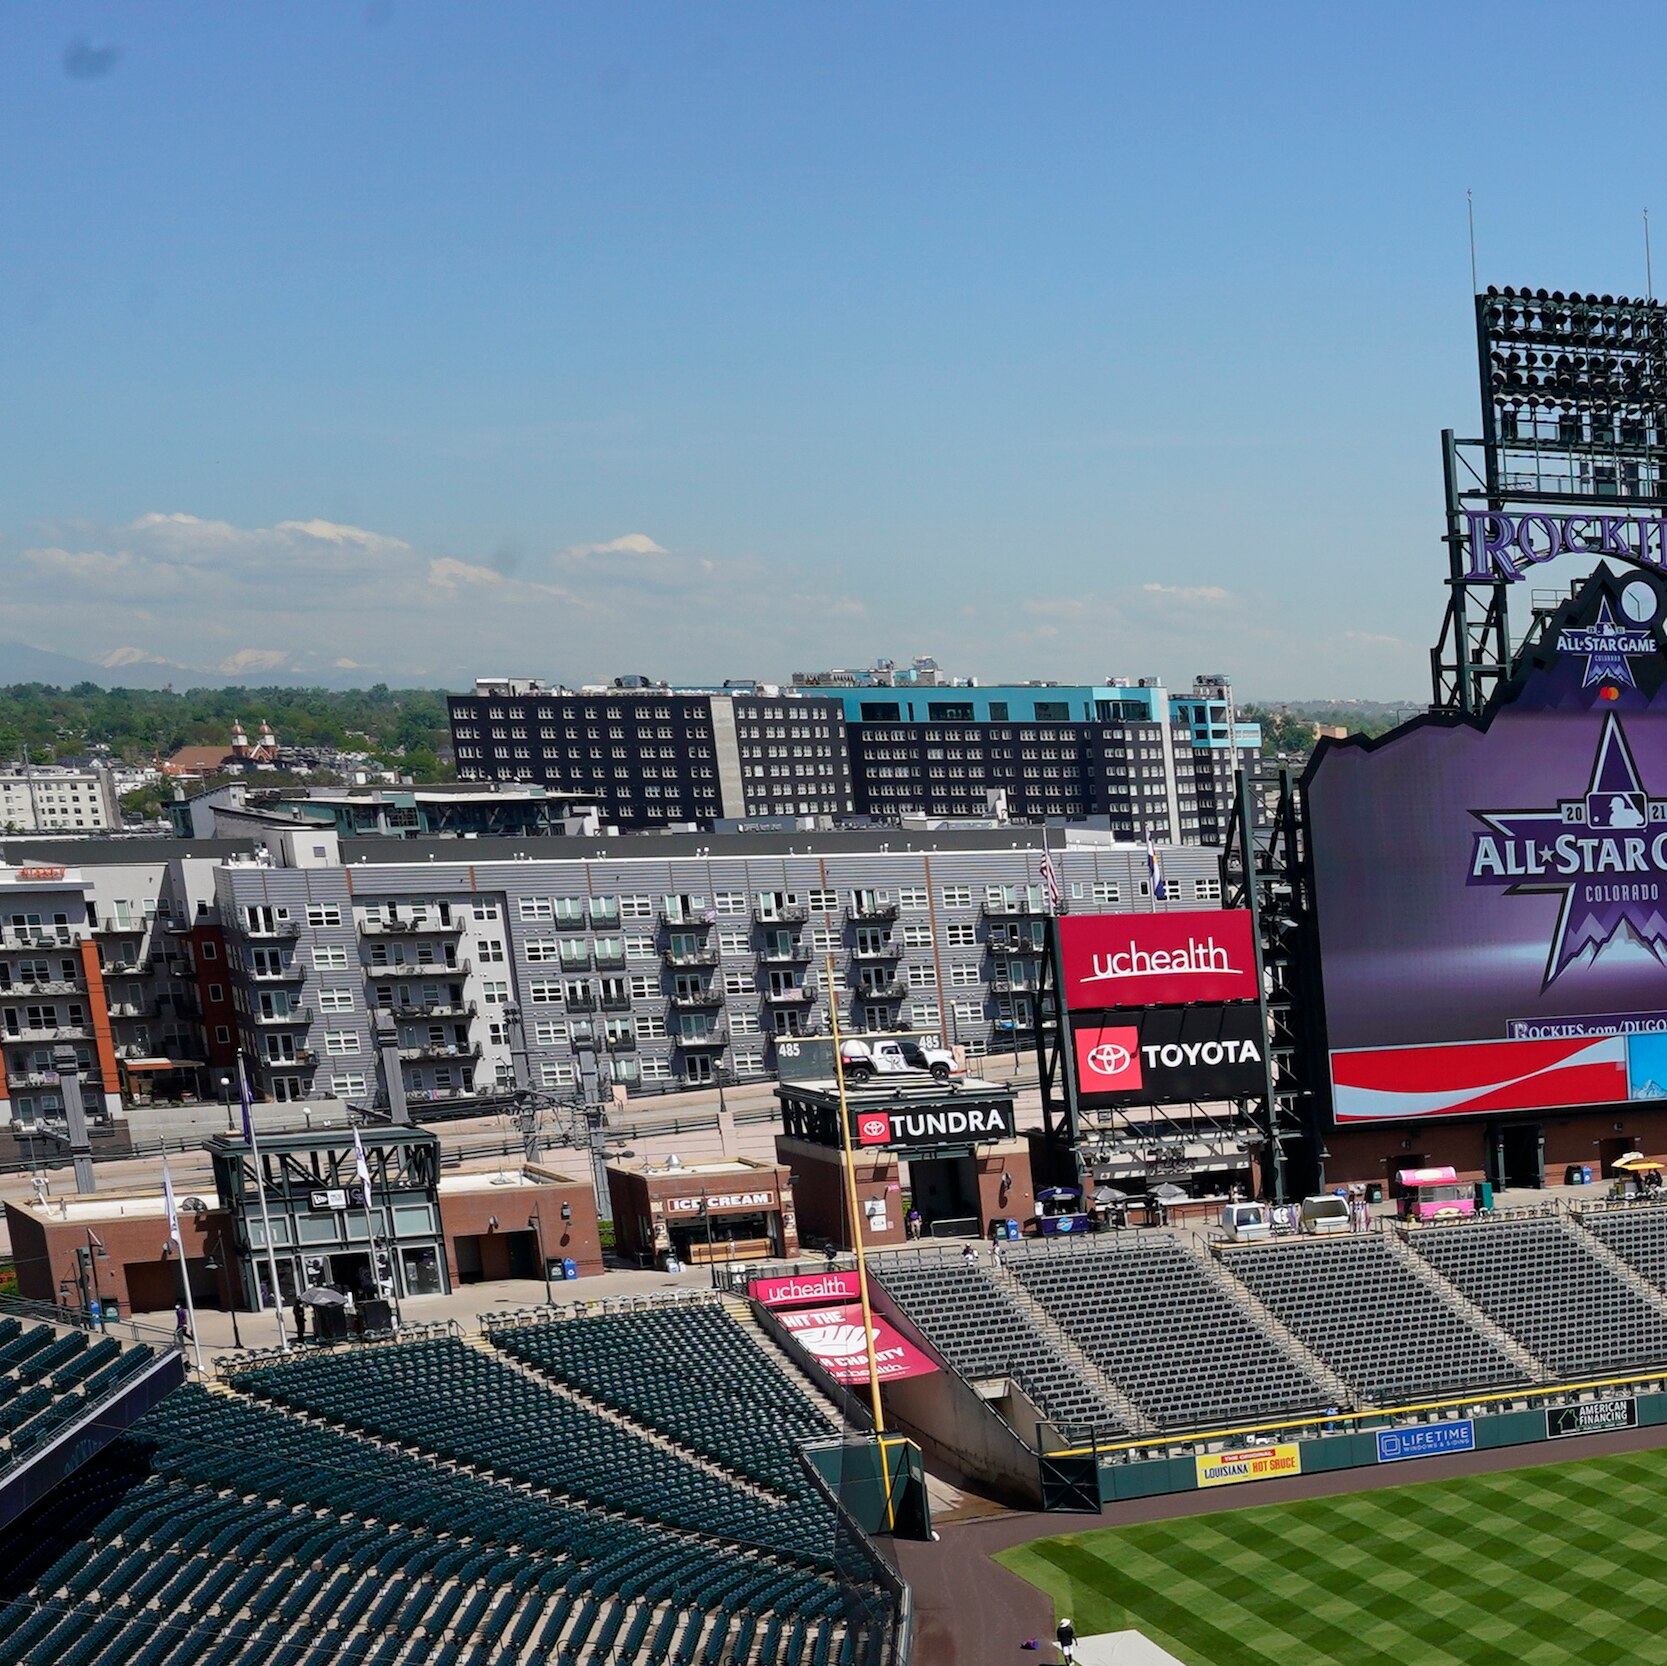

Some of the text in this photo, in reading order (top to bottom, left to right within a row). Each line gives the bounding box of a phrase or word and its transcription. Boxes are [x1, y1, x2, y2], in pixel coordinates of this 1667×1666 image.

[1617, 637, 1657, 652] GAME
[1566, 804, 1667, 821] 20 21
[1585, 883, 1659, 902] COLORADO
[1091, 936, 1230, 978] uchealth
[779, 1042, 800, 1057] 485
[918, 1034, 941, 1050] 485
[1141, 1039, 1262, 1069] TOYOTA
[889, 1108, 1006, 1137] TUNDRA
[706, 1193, 770, 1207] CREAM
[768, 1275, 847, 1300] uchealth
[781, 1310, 846, 1328] HIT THE
[1578, 1401, 1628, 1417] AMERICAN
[1578, 1411, 1628, 1426] FINANCING
[1401, 1426, 1469, 1447] LIFETIME
[1403, 1444, 1437, 1452] WINDOWS
[1252, 1456, 1296, 1474] HOT SAUCE
